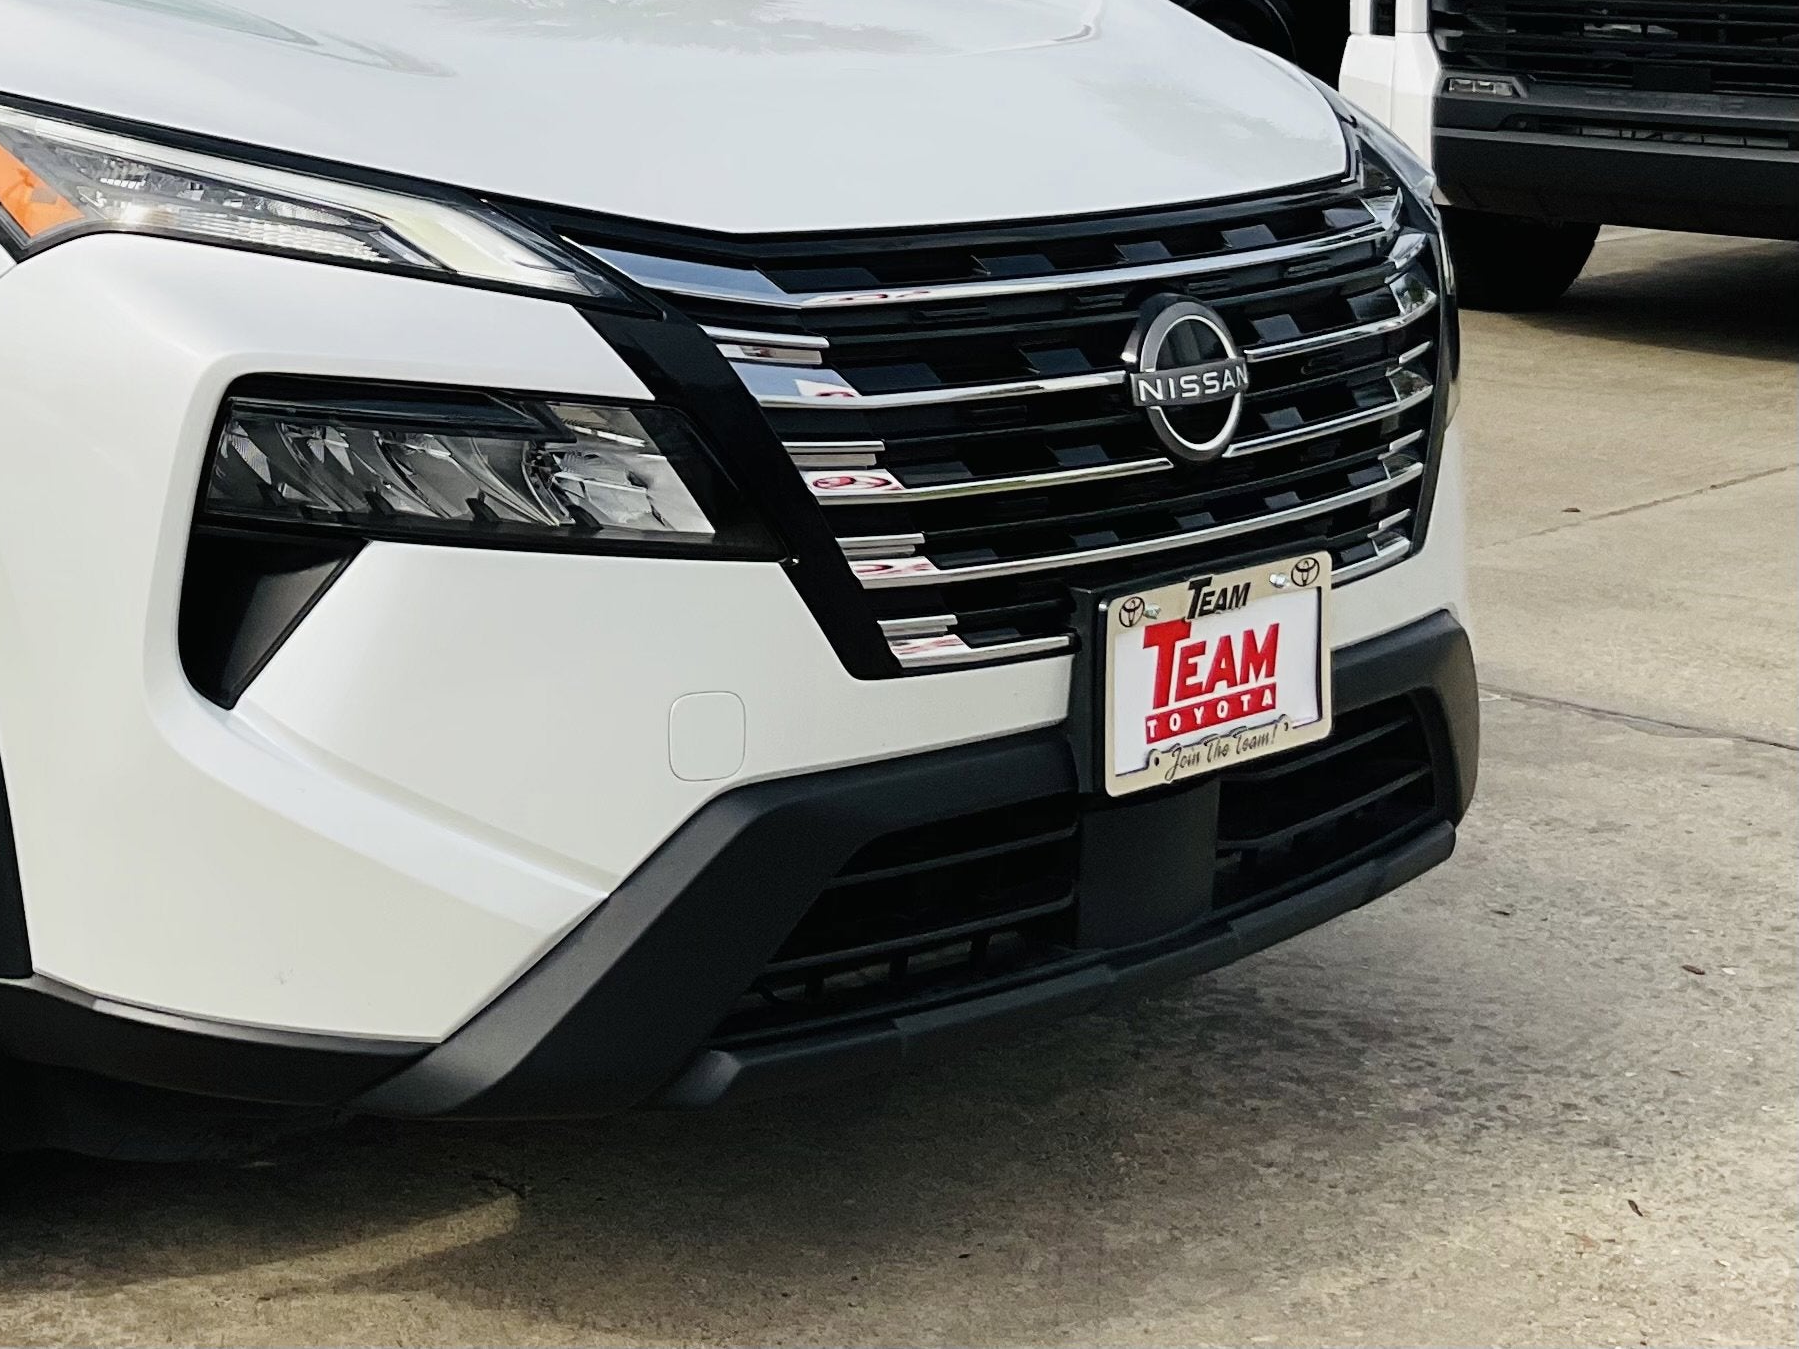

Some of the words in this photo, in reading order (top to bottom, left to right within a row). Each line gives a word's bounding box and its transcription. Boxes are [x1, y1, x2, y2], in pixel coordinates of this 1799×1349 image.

[1137, 363, 1249, 402] NISSAN
[1186, 576, 1251, 620] TEAM
[1142, 619, 1280, 710] TEAM
[1146, 688, 1274, 739] TOYOTA
[1164, 746, 1201, 782] Join
[1202, 736, 1230, 763] The
